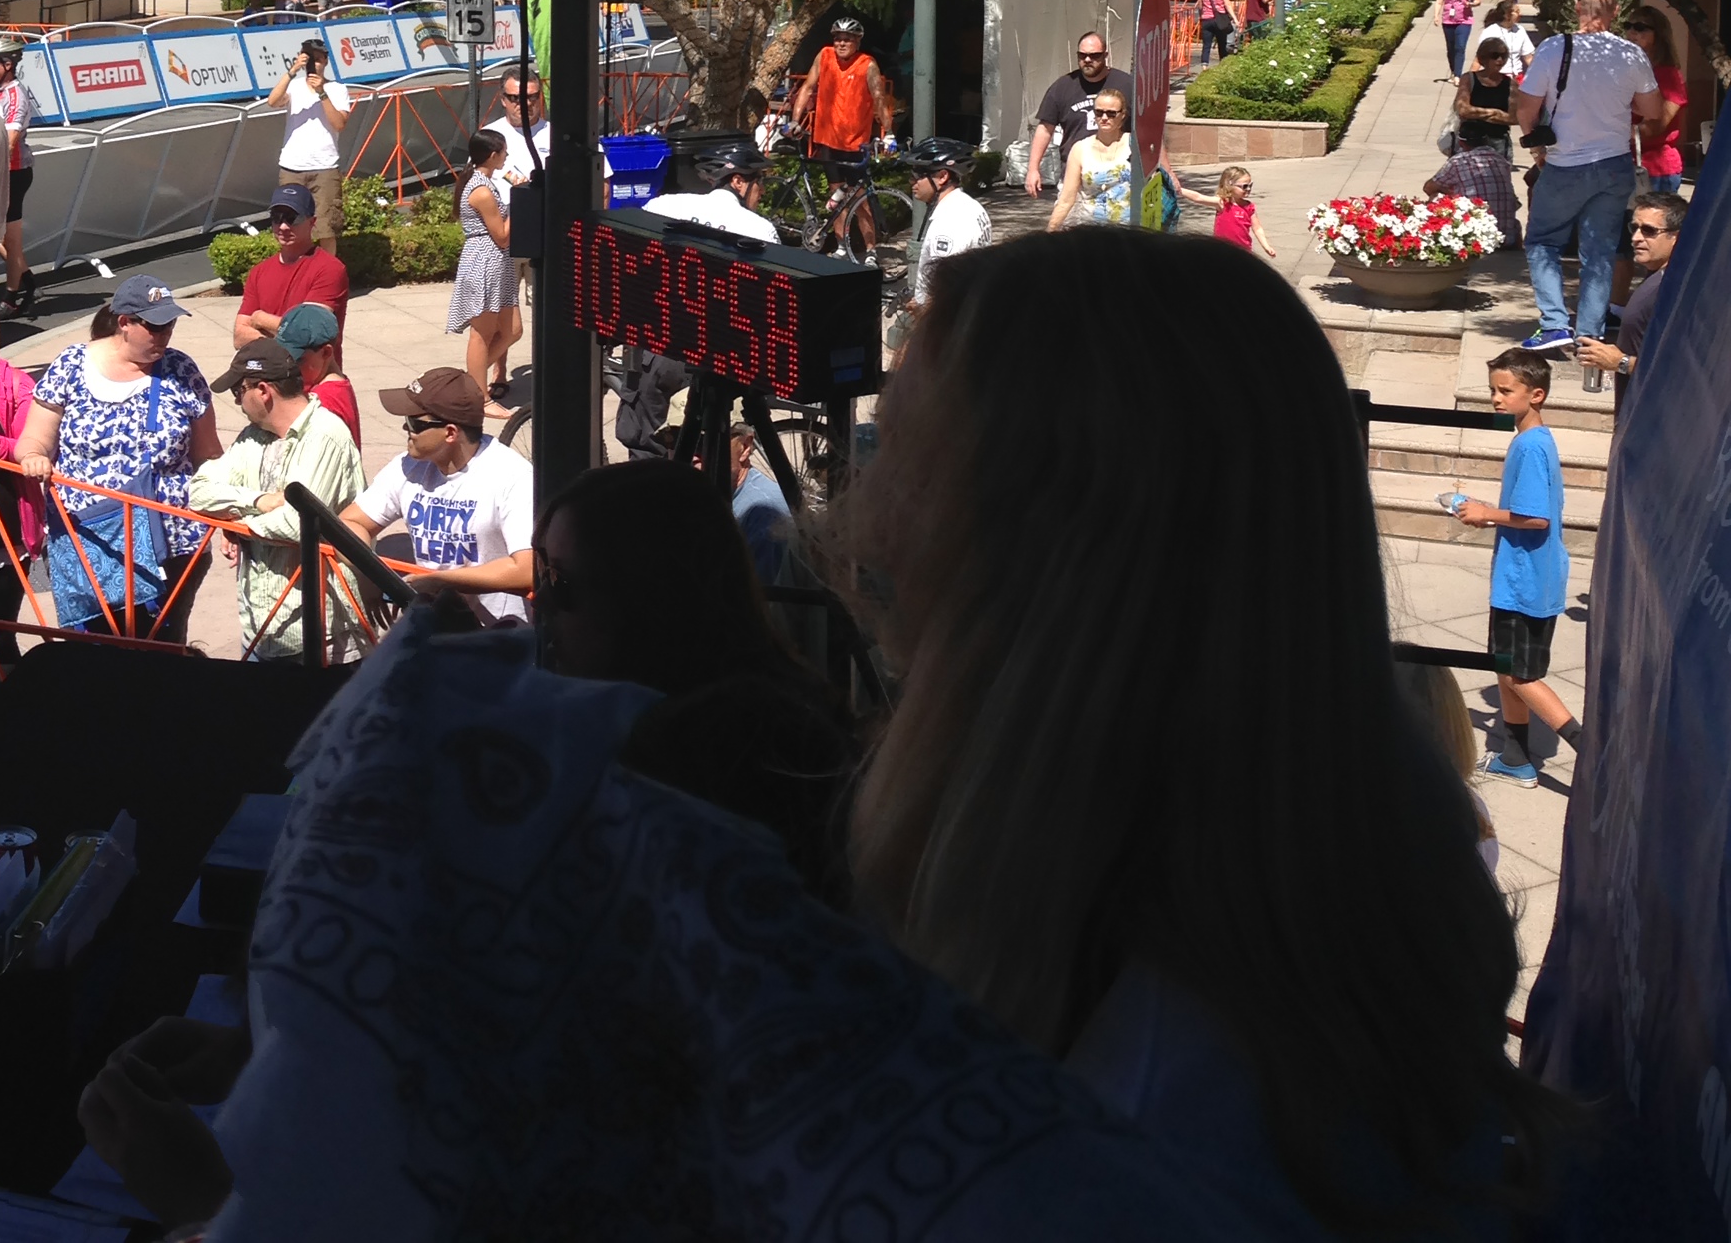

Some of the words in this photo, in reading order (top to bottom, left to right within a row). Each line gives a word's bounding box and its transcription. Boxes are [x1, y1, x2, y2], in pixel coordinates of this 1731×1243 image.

[456, 9, 485, 36] 15
[352, 34, 391, 50] Champion
[359, 46, 392, 63] System
[76, 65, 141, 88] SRAM
[191, 63, 237, 88] OPTUM
[1137, 19, 1168, 117] STOP
[567, 219, 800, 399] 10:39:58
[408, 501, 477, 534] DIRTY
[414, 539, 479, 565] LEAN
